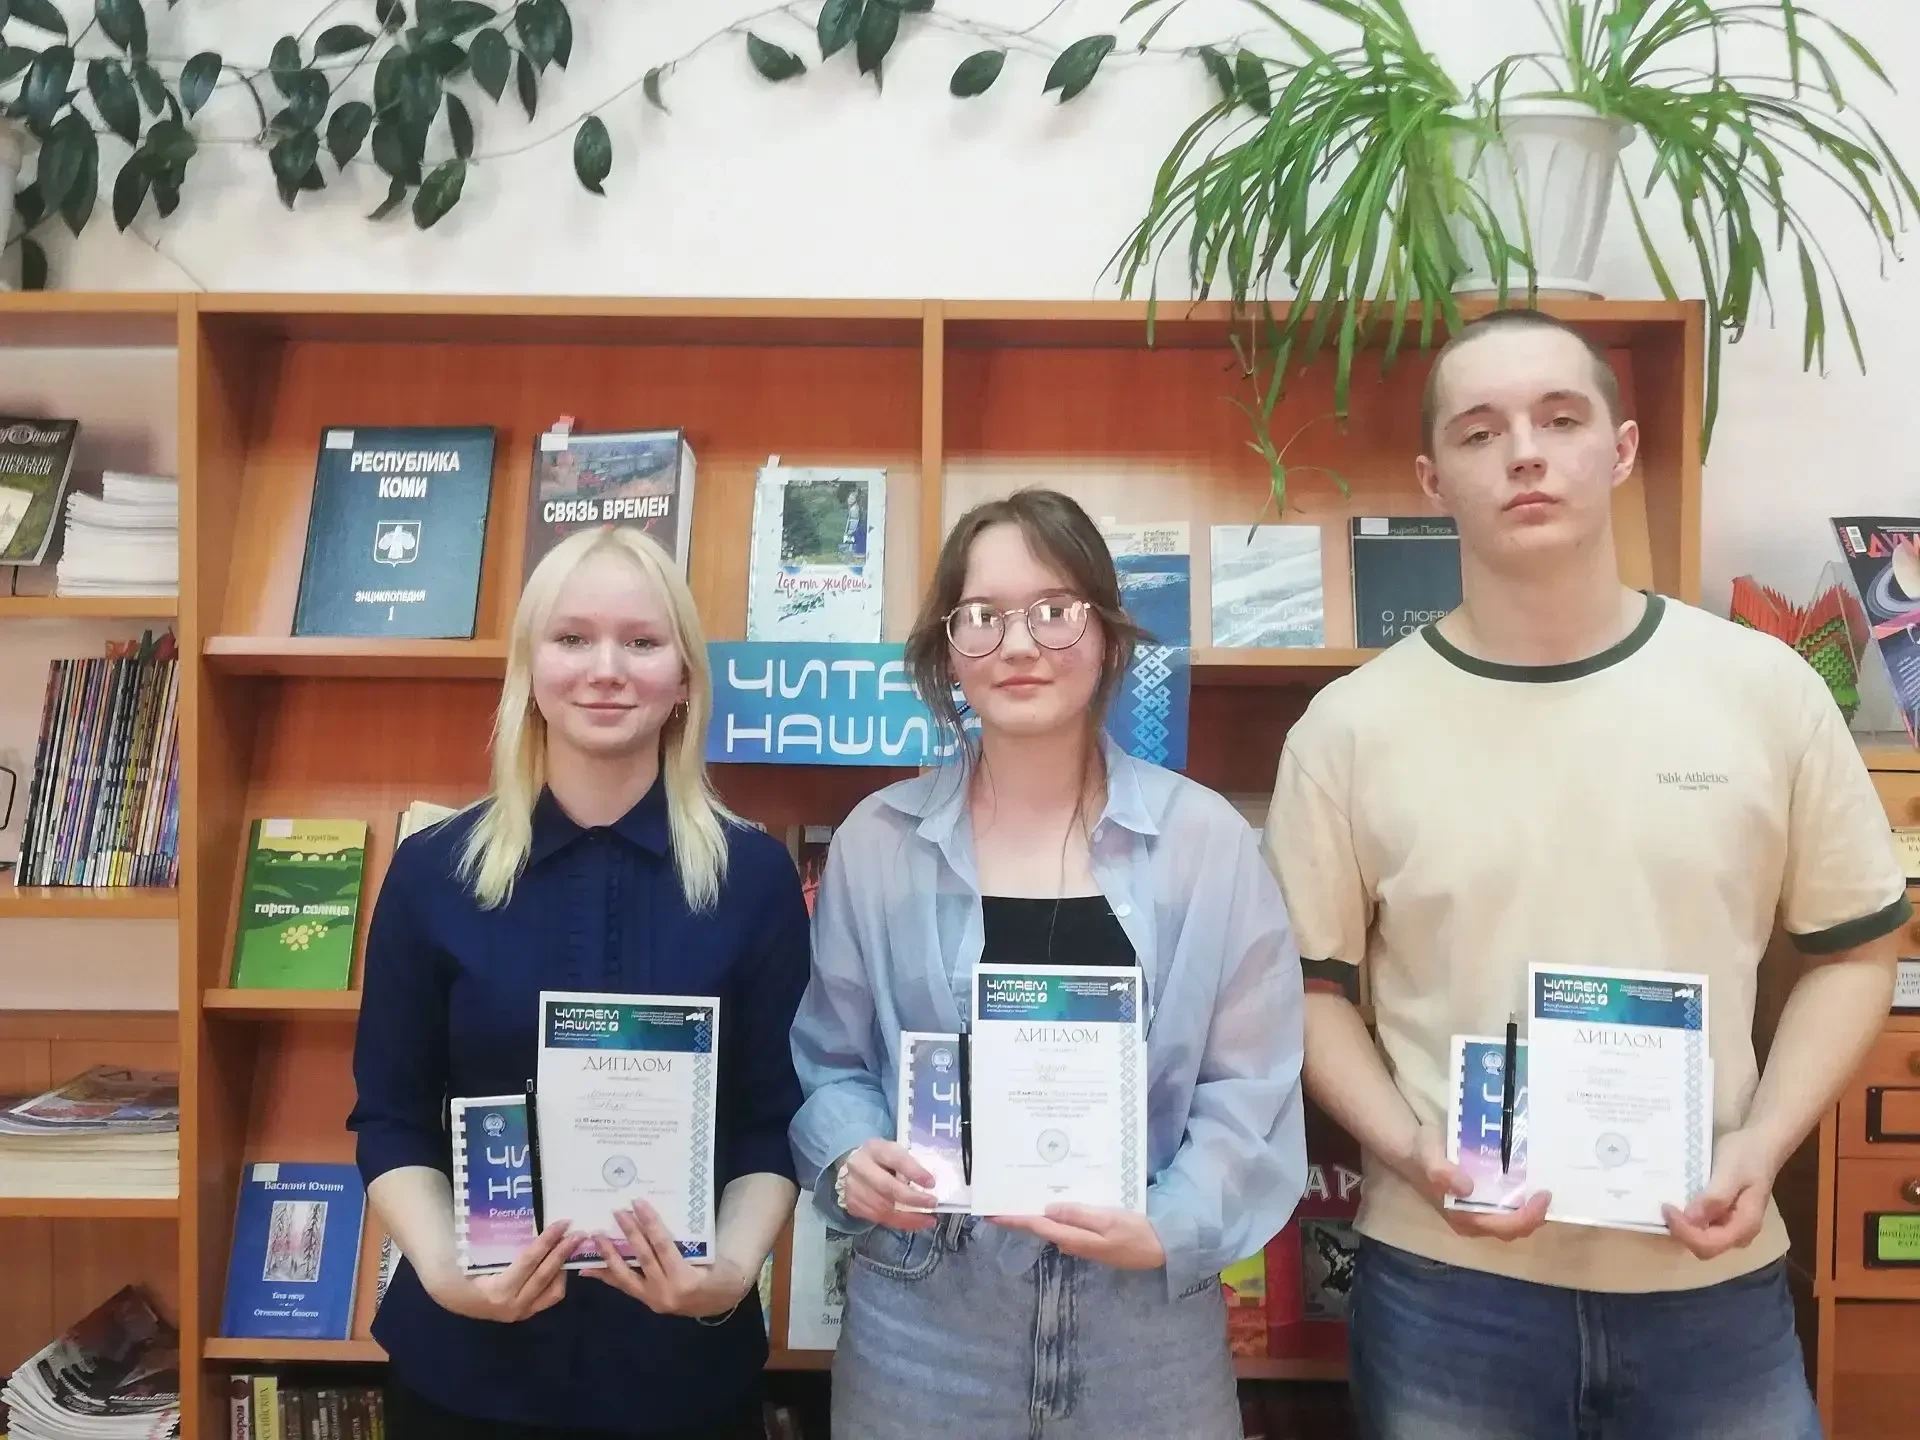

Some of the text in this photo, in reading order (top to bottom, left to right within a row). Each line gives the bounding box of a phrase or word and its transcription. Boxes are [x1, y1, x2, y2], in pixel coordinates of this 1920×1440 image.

[350, 451, 460, 472] РЕСПУБЛИКА
[378, 476, 428, 498] КОМИ
[543, 495, 669, 523] СВЯЗЬ ВРЕМЕН
[1388, 526, 1419, 535] ндрей
[354, 590, 426, 603] ЭНЦИКЛОПЕДИЯ
[387, 606, 395, 621] 1
[1381, 610, 1450, 623] О ЛЮБВ
[1382, 624, 1394, 638] И
[1684, 772, 1729, 784] Athletics
[254, 903, 350, 918] горсть солнца
[987, 979, 1048, 991] ЧИТАЕМ
[1543, 977, 1608, 994] ЧИТАЕМ
[987, 991, 1036, 1003] НАШИХ
[1543, 991, 1596, 1006] НАШИХ
[555, 1008, 619, 1020] ЧИТАЕМ
[554, 1020, 606, 1031] НАШИХ
[1014, 1027, 1099, 1044] ДИПЛОМ
[1573, 1028, 1663, 1049] ДИПЛОМ
[582, 1056, 672, 1073] ДИПЛОМ
[264, 1180, 344, 1192] Василий Юхнин
